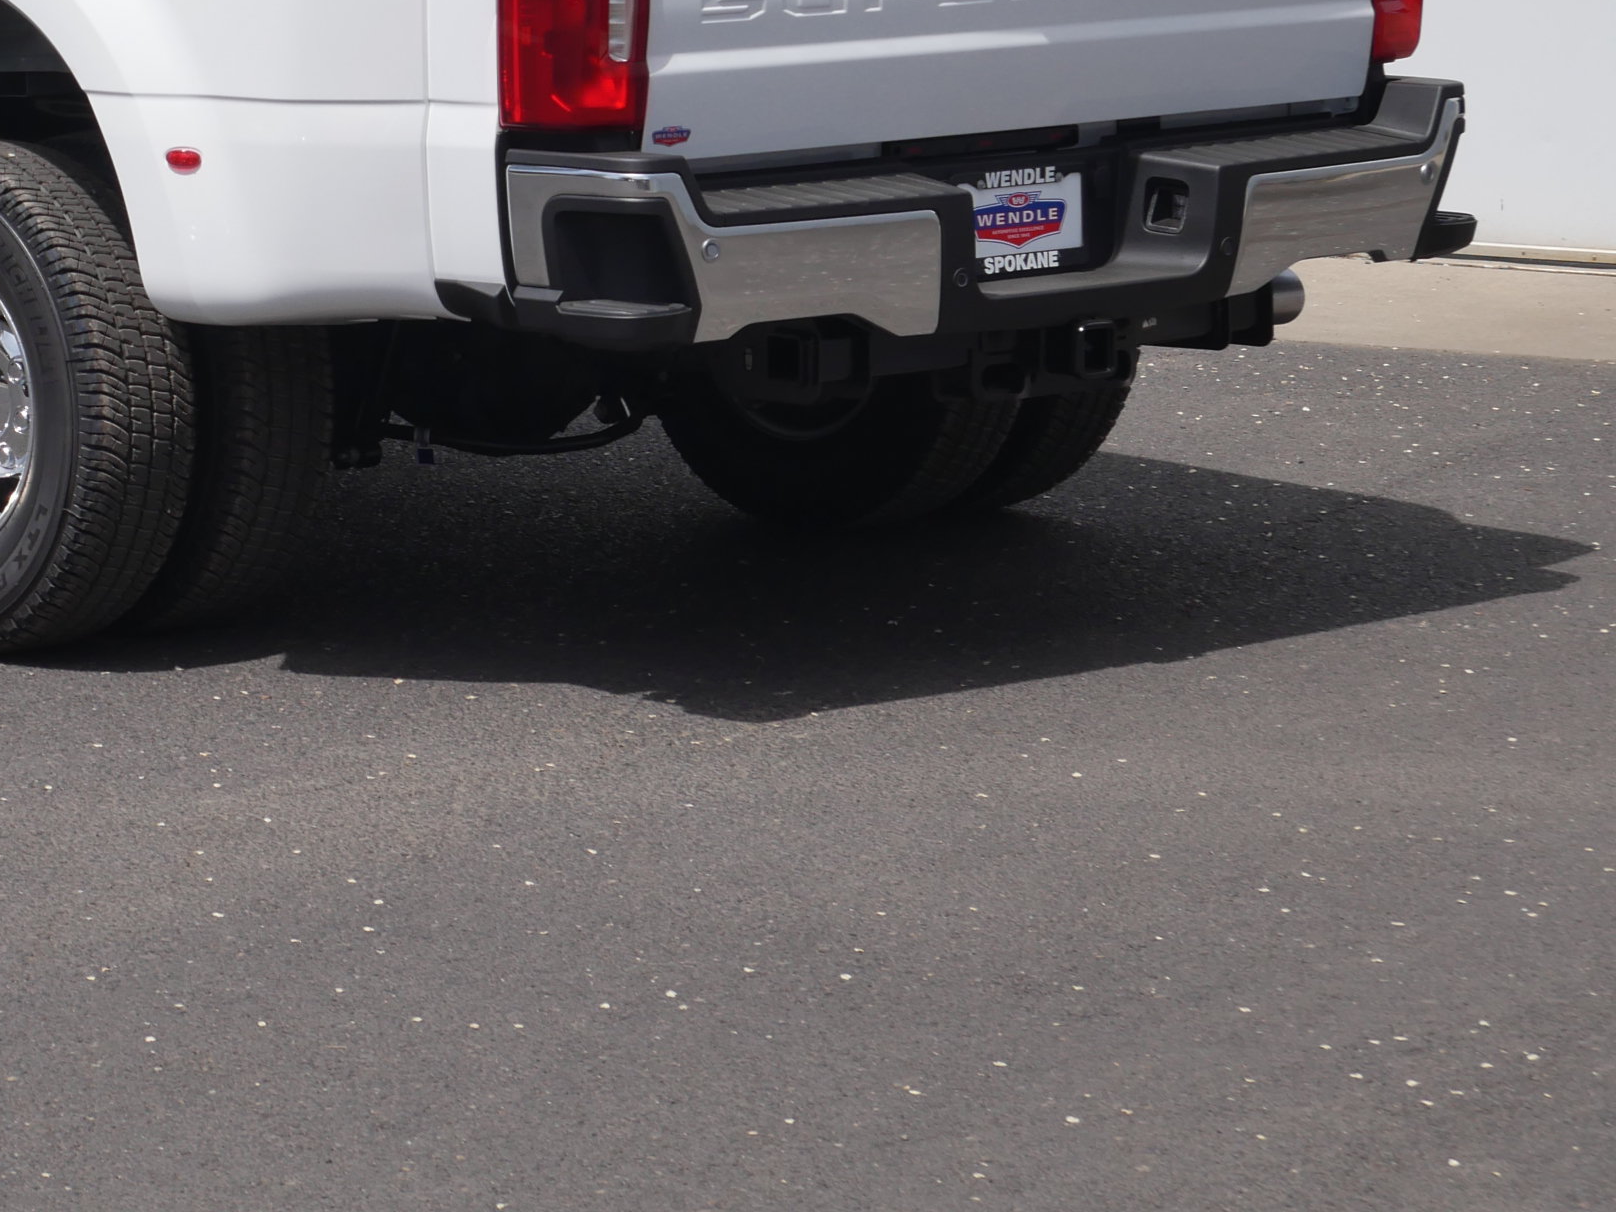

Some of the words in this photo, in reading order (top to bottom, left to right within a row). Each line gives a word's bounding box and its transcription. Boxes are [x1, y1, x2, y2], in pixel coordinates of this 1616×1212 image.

[985, 166, 1056, 188] WENDLE
[977, 207, 1059, 227] WENDLE
[984, 251, 1059, 275] SPOKANE
